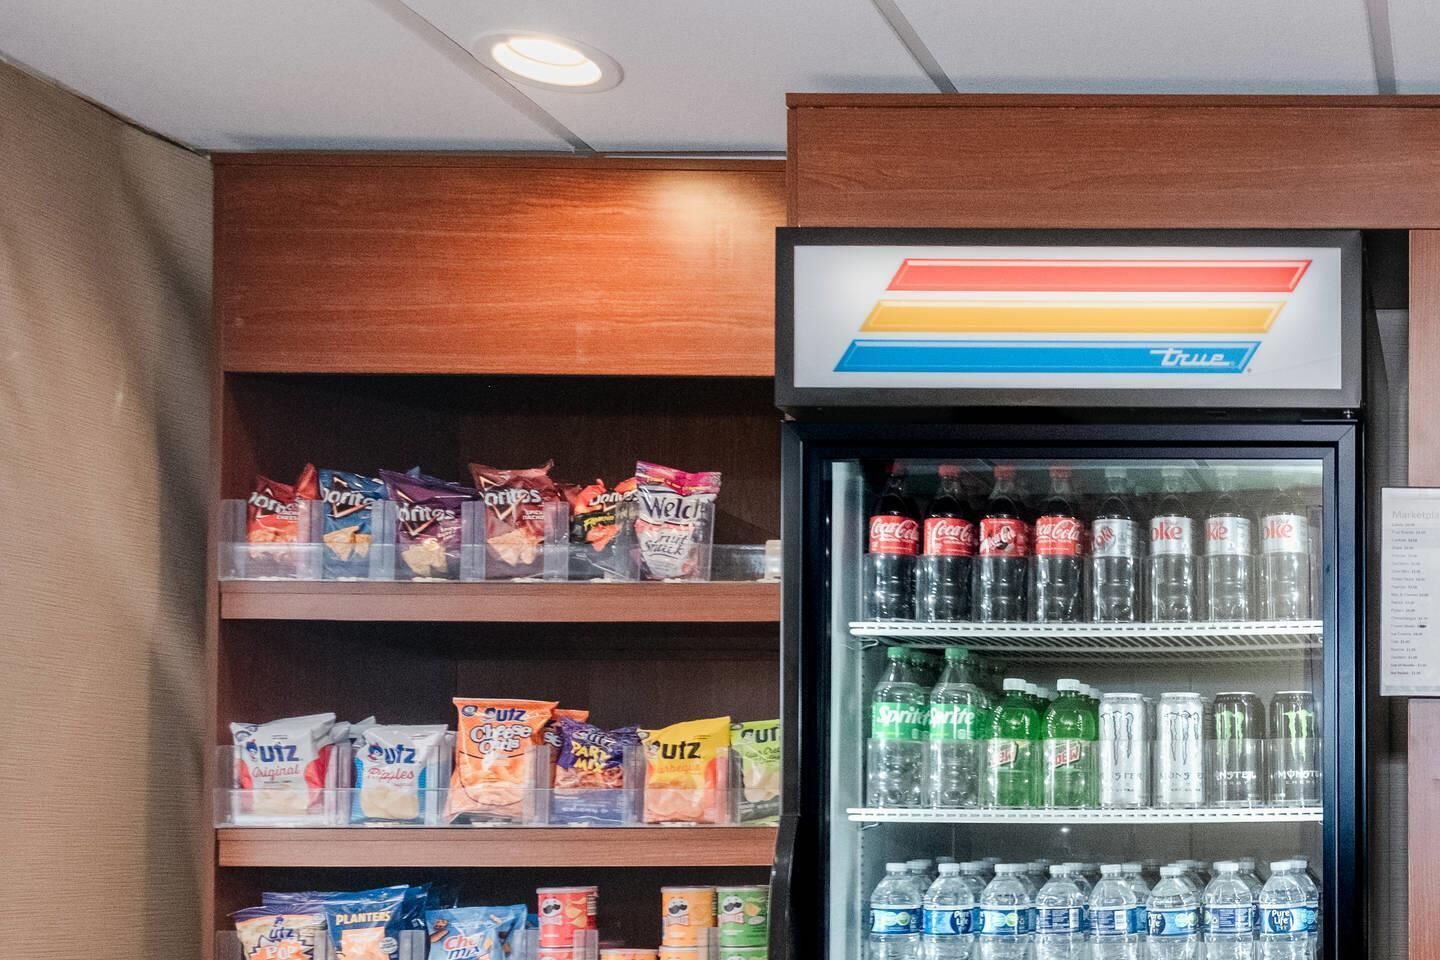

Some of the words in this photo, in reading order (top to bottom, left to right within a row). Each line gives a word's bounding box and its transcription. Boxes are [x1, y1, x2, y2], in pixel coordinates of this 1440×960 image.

[1149, 347, 1236, 367] true
[470, 723, 533, 743] Cheese
[335, 911, 391, 926] PLANTERS
[1272, 909, 1291, 918] Pure
